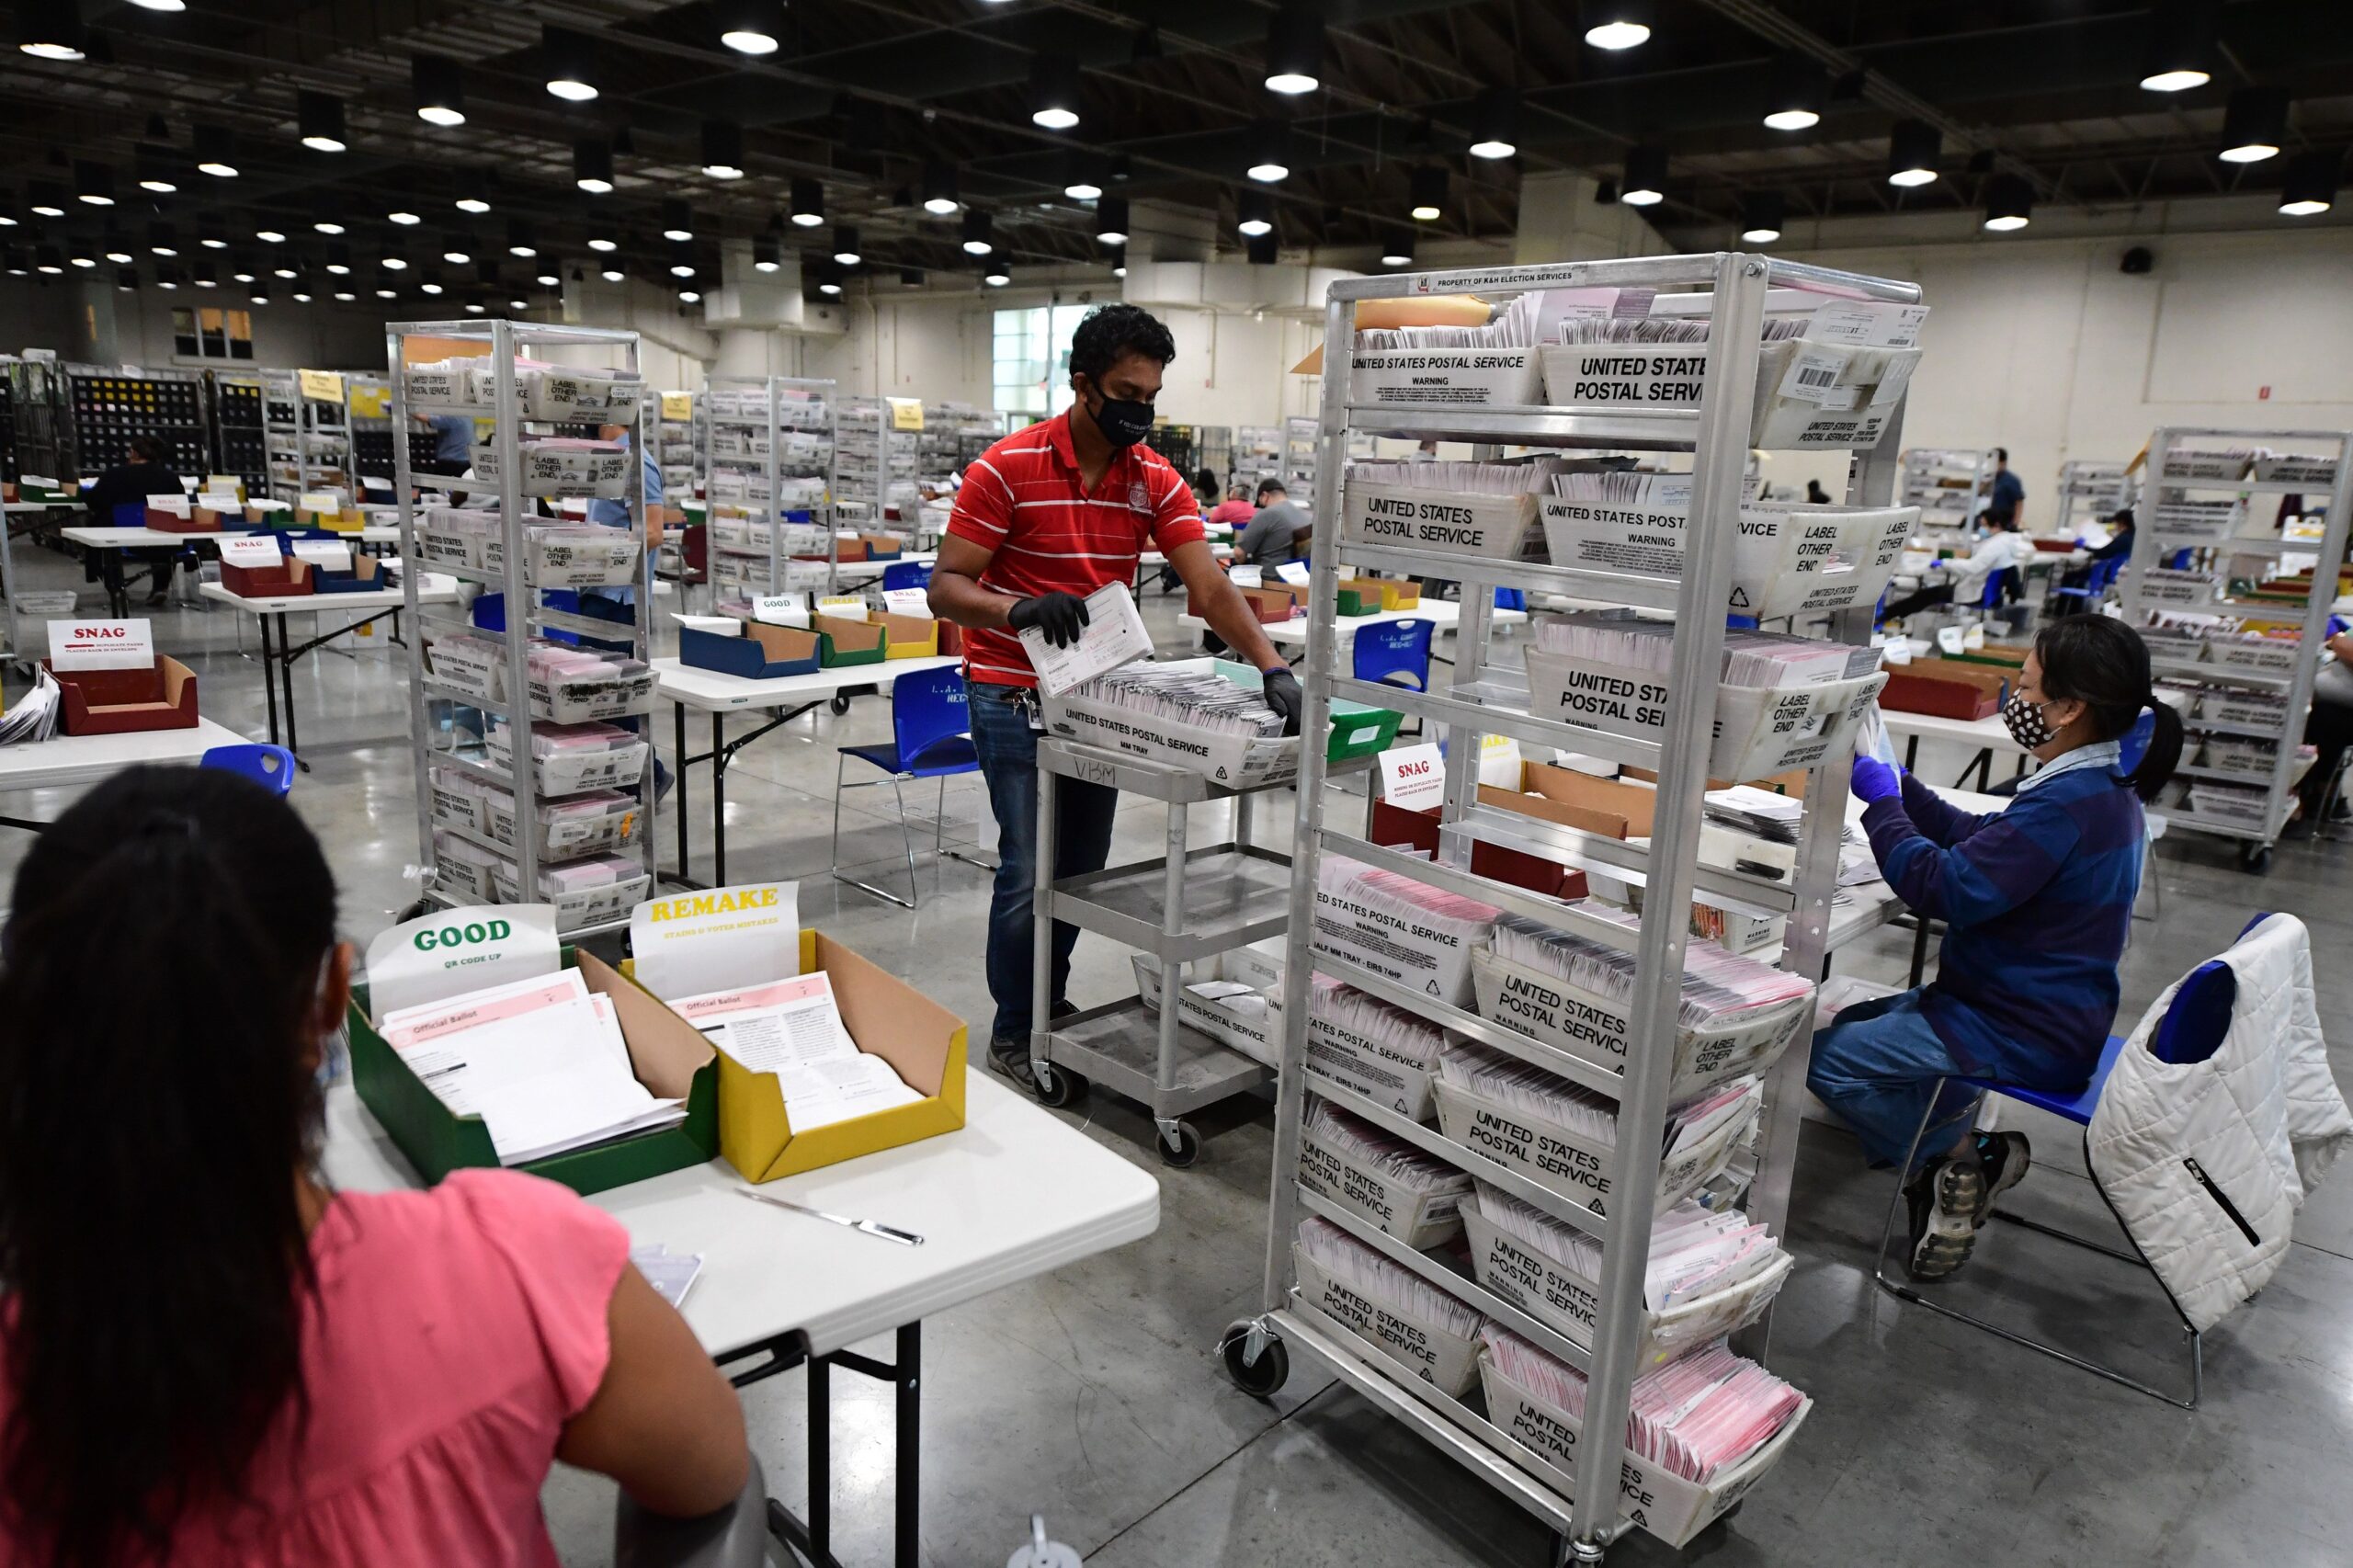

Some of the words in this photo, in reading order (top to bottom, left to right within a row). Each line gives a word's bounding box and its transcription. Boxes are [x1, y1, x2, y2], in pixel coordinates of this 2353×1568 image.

[1438, 278, 1471, 287] PROPERTY
[1483, 276, 1499, 284] K&H
[1501, 275, 1535, 283] ELECTION
[1537, 273, 1572, 281] SERVICES
[1352, 358, 1384, 369] UNITED
[1387, 358, 1425, 369] STATES
[1428, 357, 1470, 368] POSTAL
[1473, 357, 1524, 368] SERVICE
[1581, 358, 1646, 375] UNITED
[552, 380, 577, 389] LABEL
[1412, 377, 1449, 385] WARNING
[1574, 382, 1643, 400] POSTAL
[1807, 422, 1834, 430] UNITED
[1834, 422, 1858, 430] STATES
[1798, 433, 1824, 442] POSTAL
[1824, 433, 1854, 442] SERVICE
[1369, 497, 1415, 517] UNITED
[1420, 505, 1472, 524] STATES
[1547, 506, 1589, 519] UNITED
[1594, 510, 1643, 525] STATES
[1648, 515, 1688, 529] POST
[1364, 517, 1414, 538] POSTAL
[1419, 525, 1483, 546] SERVICE
[1737, 522, 1778, 536] VICE
[1805, 527, 1837, 539] LABEL
[1886, 522, 1908, 535] LABEL
[426, 534, 441, 544] UNITED
[442, 536, 462, 547] STATES
[1628, 534, 1676, 547] WARNING
[1797, 544, 1832, 555] OTHER
[1879, 538, 1904, 551] OTHER
[426, 544, 444, 555] POSTAL
[444, 547, 467, 558] SERVICE
[1875, 553, 1893, 566] END
[764, 599, 790, 608] GOOD
[74, 628, 125, 638] SNAG
[1568, 671, 1635, 698] UNITED
[1561, 692, 1630, 721] POSTAL
[1779, 695, 1811, 707] LABEL
[1773, 708, 1806, 720] OTHER
[1065, 708, 1097, 726] UNITED
[1098, 717, 1131, 736] STATES
[1131, 728, 1165, 747] POSTAL
[1167, 738, 1209, 757] SERVICE
[1564, 718, 1598, 731] WARNING
[1773, 722, 1794, 733] END
[1120, 741, 1131, 751] MM
[1132, 744, 1149, 756] TRAY
[1398, 760, 1429, 778] SNAG
[650, 887, 779, 924] REMAKE
[707, 924, 735, 934] VOTER
[736, 917, 779, 929] MISTAKES
[1331, 897, 1367, 917] STATES
[1370, 911, 1407, 932] POSTAL
[1411, 925, 1459, 948] SERVICE
[1356, 921, 1389, 939] WARNING
[414, 919, 511, 951] GOOD
[1747, 927, 1770, 938] WARNING
[444, 960, 459, 969] QR
[461, 957, 486, 966] CODE
[488, 953, 502, 961] UP
[1343, 951, 1360, 964] TRAY
[1367, 961, 1382, 973] EIRS
[1384, 967, 1402, 979] 74HP
[687, 999, 716, 1011] Official
[718, 994, 742, 1006] Ballot
[1506, 974, 1562, 1008] UNITED
[1564, 991, 1627, 1034] STATES
[413, 1017, 449, 1035] Official
[451, 1009, 478, 1024] Ballot
[1202, 1007, 1231, 1028] POSTAL
[1233, 1022, 1266, 1042] SERVICE
[1495, 1014, 1536, 1036] WARNING
[1498, 992, 1557, 1028] POSTAL
[1562, 1010, 1628, 1057] SERVIC
[1324, 1039, 1358, 1057] WARNING
[1337, 1030, 1376, 1053] POSTAL
[1379, 1048, 1425, 1071] SERVICE
[1703, 1038, 1736, 1051] LABEL
[1696, 1050, 1732, 1063] OTHER
[1695, 1062, 1718, 1074] END
[1313, 1064, 1331, 1080] TRAY
[1336, 1074, 1352, 1089] EIRS
[1353, 1082, 1371, 1096] 74HP
[1476, 1109, 1533, 1143] UNITED
[1538, 1137, 1600, 1171] STATES
[1469, 1126, 1530, 1163] POSTAL
[1536, 1154, 1611, 1194] SERVICE
[1303, 1140, 1341, 1172] UNITED
[1345, 1165, 1385, 1200] STATES
[1299, 1172, 1327, 1194] WARNING
[1300, 1154, 1340, 1188] POSTAL
[1344, 1177, 1393, 1221] SERVICE
[1489, 1253, 1540, 1294] POSTAL
[1495, 1237, 1542, 1278] UNITED
[1547, 1271, 1598, 1311] STATES
[1488, 1270, 1525, 1298] WARNING
[1323, 1308, 1357, 1333] WARNING
[1327, 1279, 1372, 1323] UNITED
[1376, 1310, 1427, 1345] STATES
[1324, 1291, 1370, 1335] POSTAL
[1375, 1324, 1437, 1365] SERVICE
[1519, 1401, 1577, 1445] UNITED
[1509, 1431, 1552, 1462] WARNING
[1514, 1415, 1574, 1462] POSTAL
